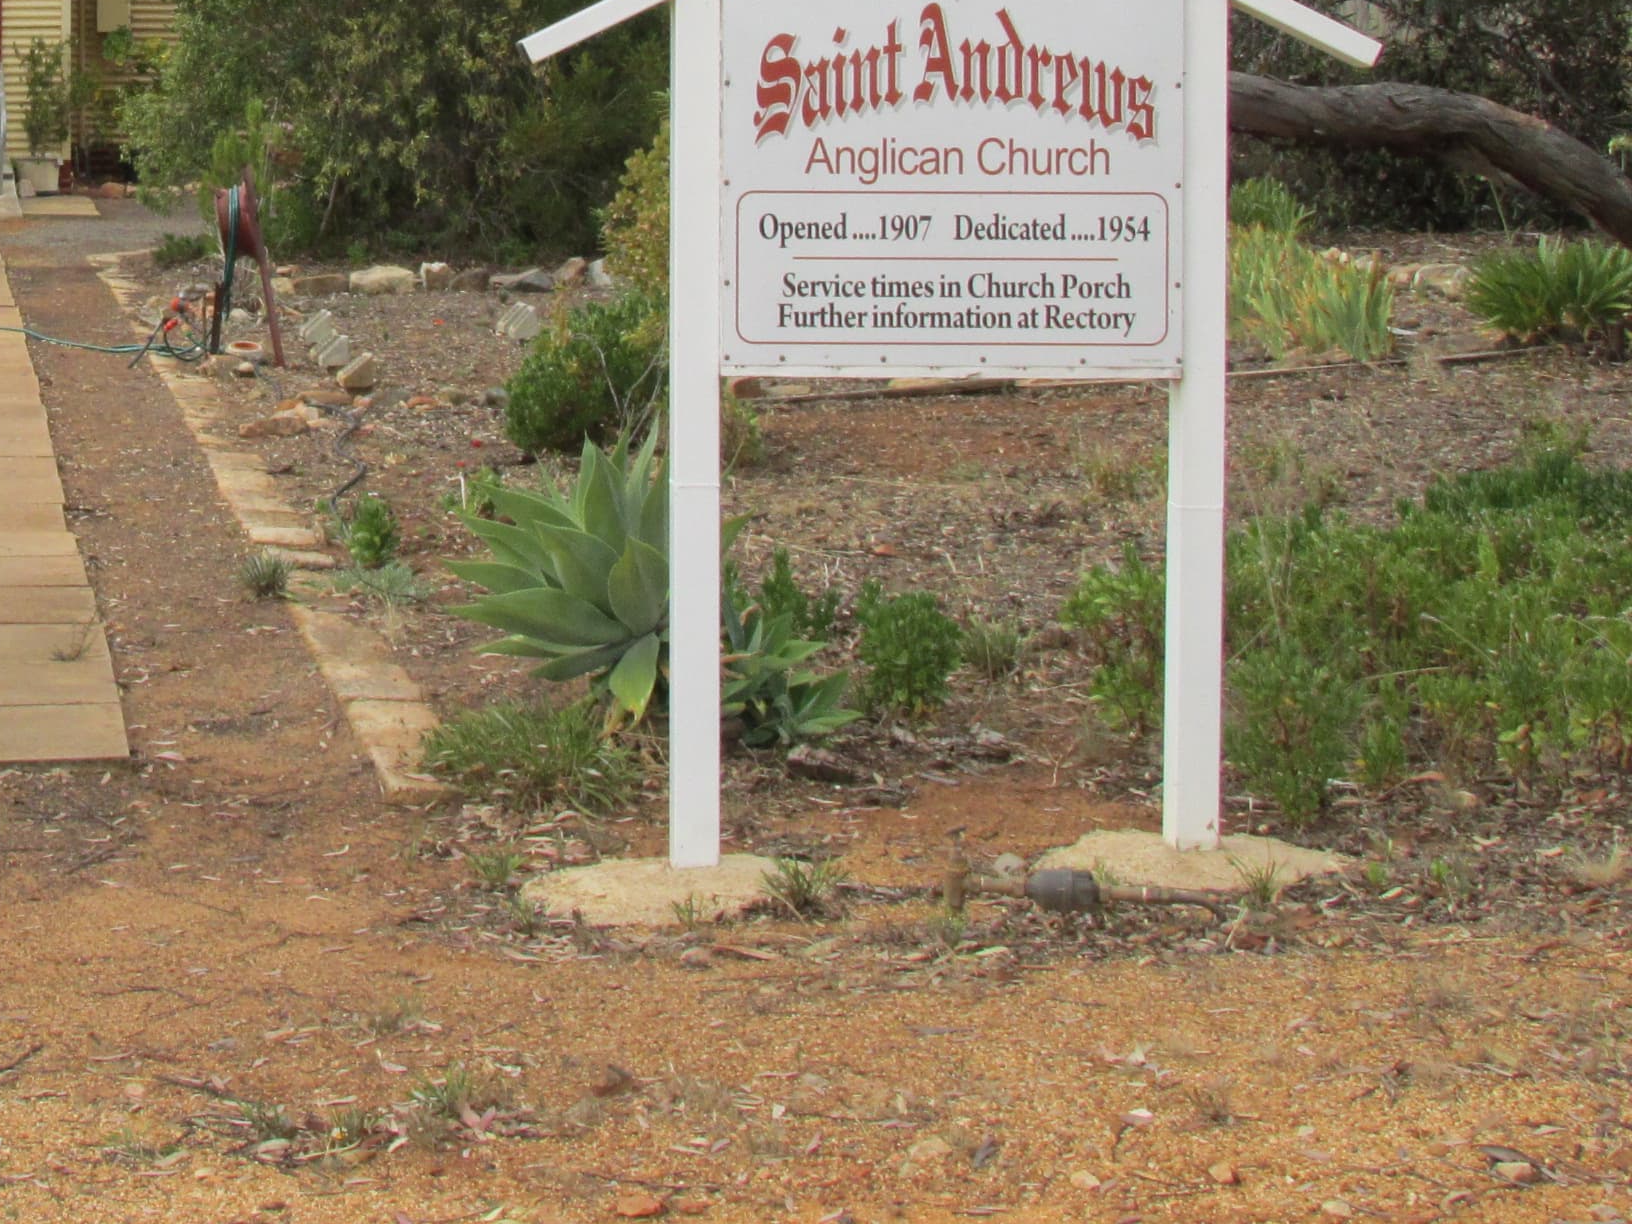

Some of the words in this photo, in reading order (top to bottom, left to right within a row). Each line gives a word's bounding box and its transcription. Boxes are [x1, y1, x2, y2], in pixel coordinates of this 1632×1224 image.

[753, 18, 906, 144] Saint
[912, 2, 1158, 143] Andrews
[804, 137, 964, 185] Anglican
[977, 137, 1110, 176] Church
[782, 272, 866, 298] Service
[871, 274, 934, 298] times
[939, 274, 962, 298] in
[967, 272, 1055, 299] Church
[1061, 272, 1132, 299] Porch
[776, 302, 868, 328] Further
[872, 302, 1012, 329] information
[1017, 307, 1039, 329] at
[1044, 304, 1137, 338] Rectory
